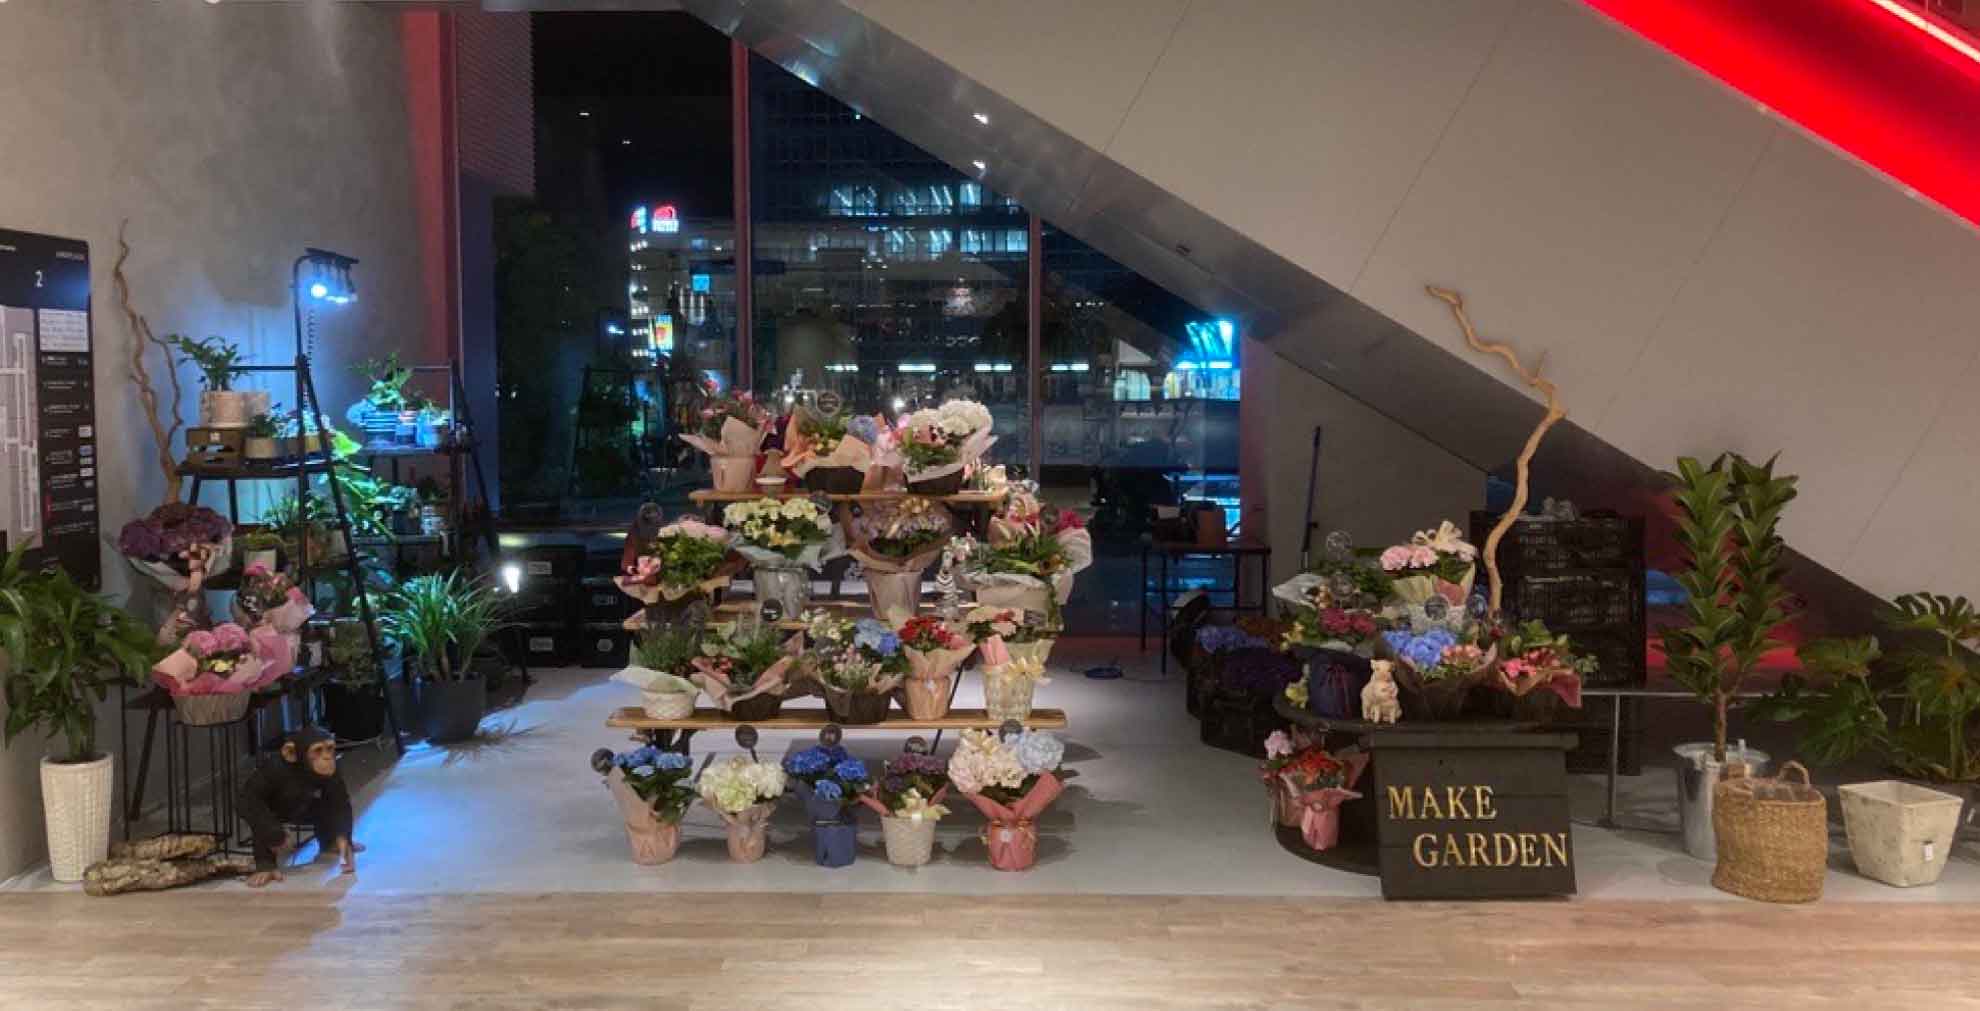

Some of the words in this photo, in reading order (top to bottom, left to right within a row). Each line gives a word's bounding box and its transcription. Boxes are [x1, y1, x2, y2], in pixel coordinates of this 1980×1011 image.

[34, 269, 43, 288] 2
[1386, 785, 1498, 820] MAKE
[1412, 832, 1569, 868] GARDEN
